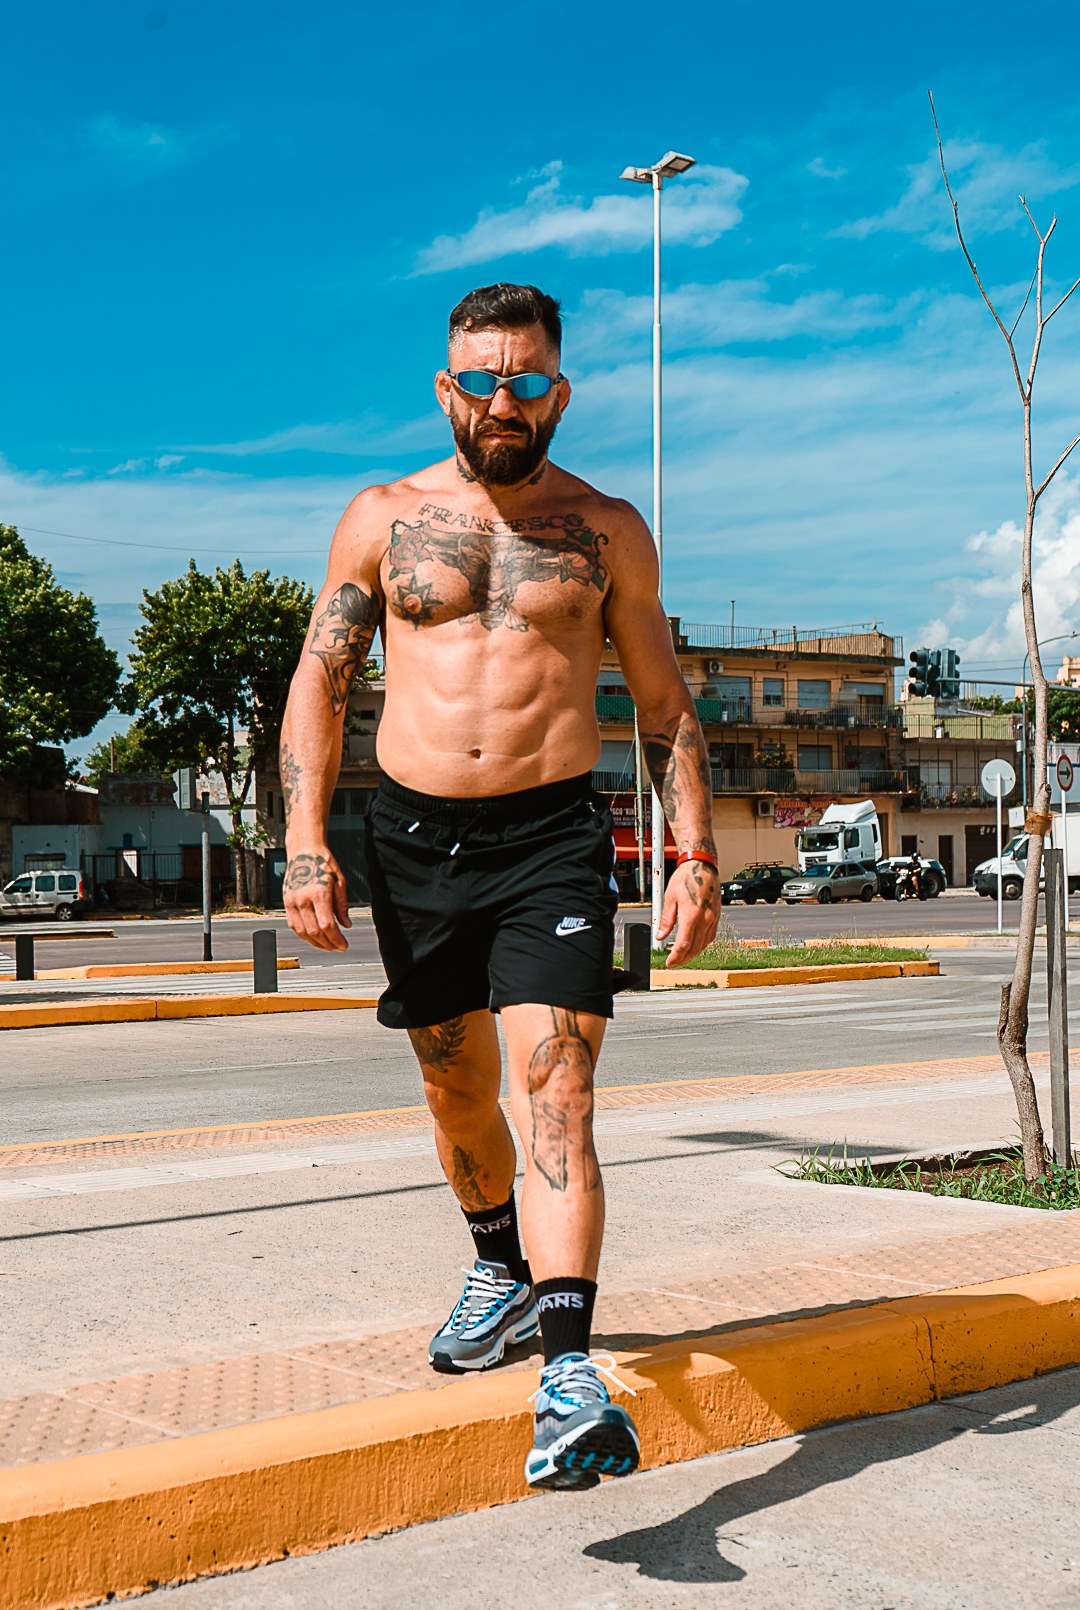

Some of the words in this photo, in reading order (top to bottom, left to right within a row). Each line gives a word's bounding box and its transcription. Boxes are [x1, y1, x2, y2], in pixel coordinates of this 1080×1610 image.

[417, 503, 584, 534] FRANCESCO
[562, 916, 586, 928] NIKE
[535, 1292, 584, 1313] VANS
